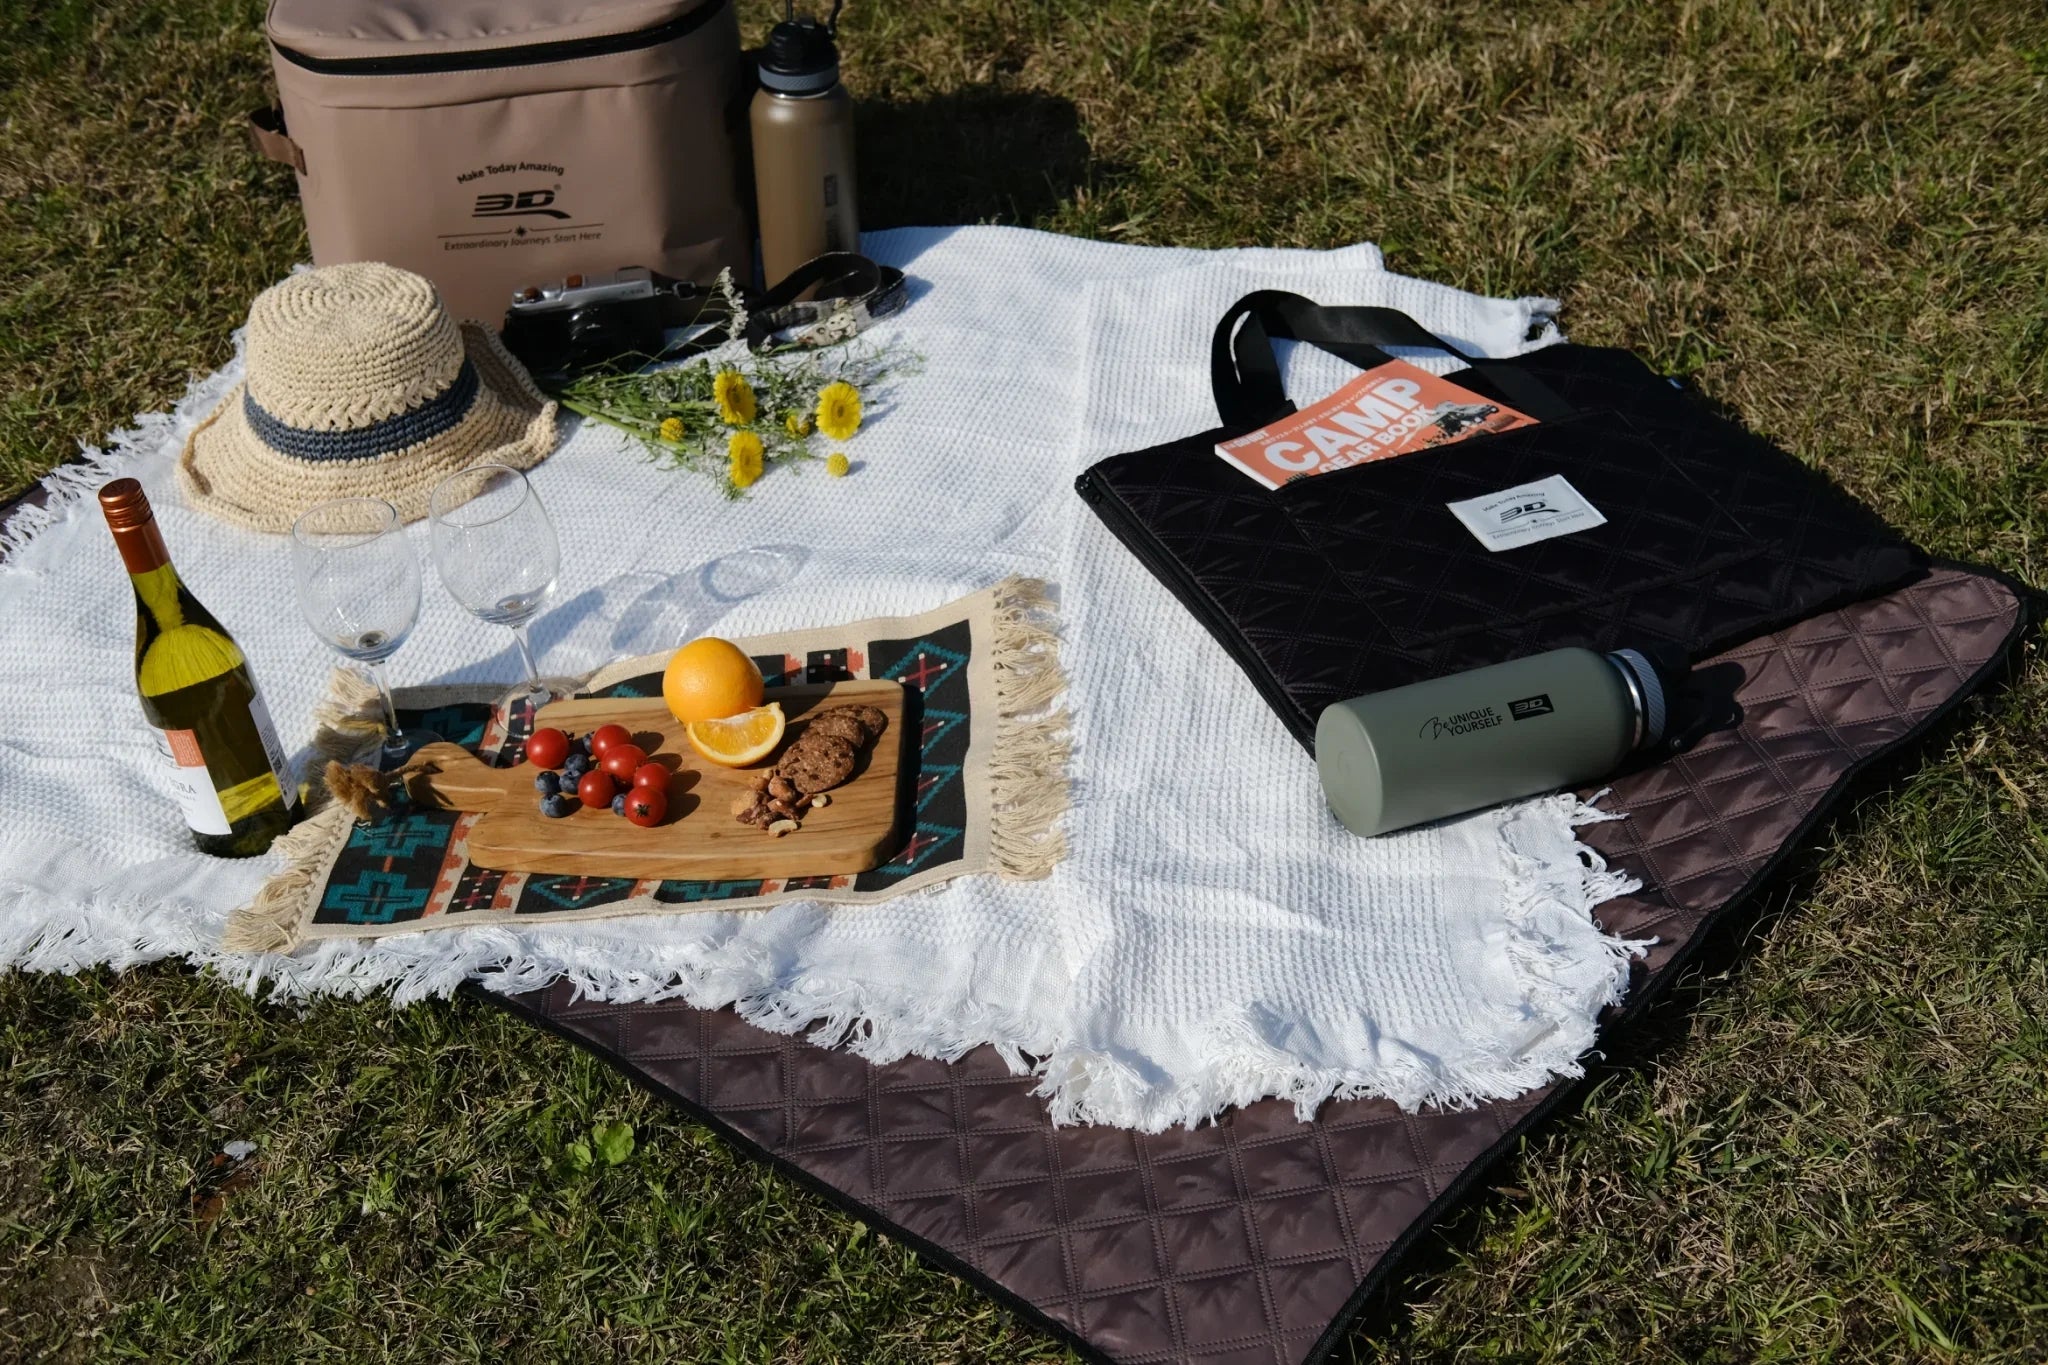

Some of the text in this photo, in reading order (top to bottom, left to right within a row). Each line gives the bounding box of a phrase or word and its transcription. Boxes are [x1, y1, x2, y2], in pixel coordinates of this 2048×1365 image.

[457, 162, 565, 184] Make Today Amazing
[444, 231, 602, 251] Extraordinary Journeys Start Here
[1264, 378, 1422, 471] CAMP
[1319, 442, 1381, 473] GEAR
[1373, 404, 1437, 445] BOOK
[1419, 706, 1495, 740] Be UNIQUE
[1447, 715, 1504, 737] YOURSELF
